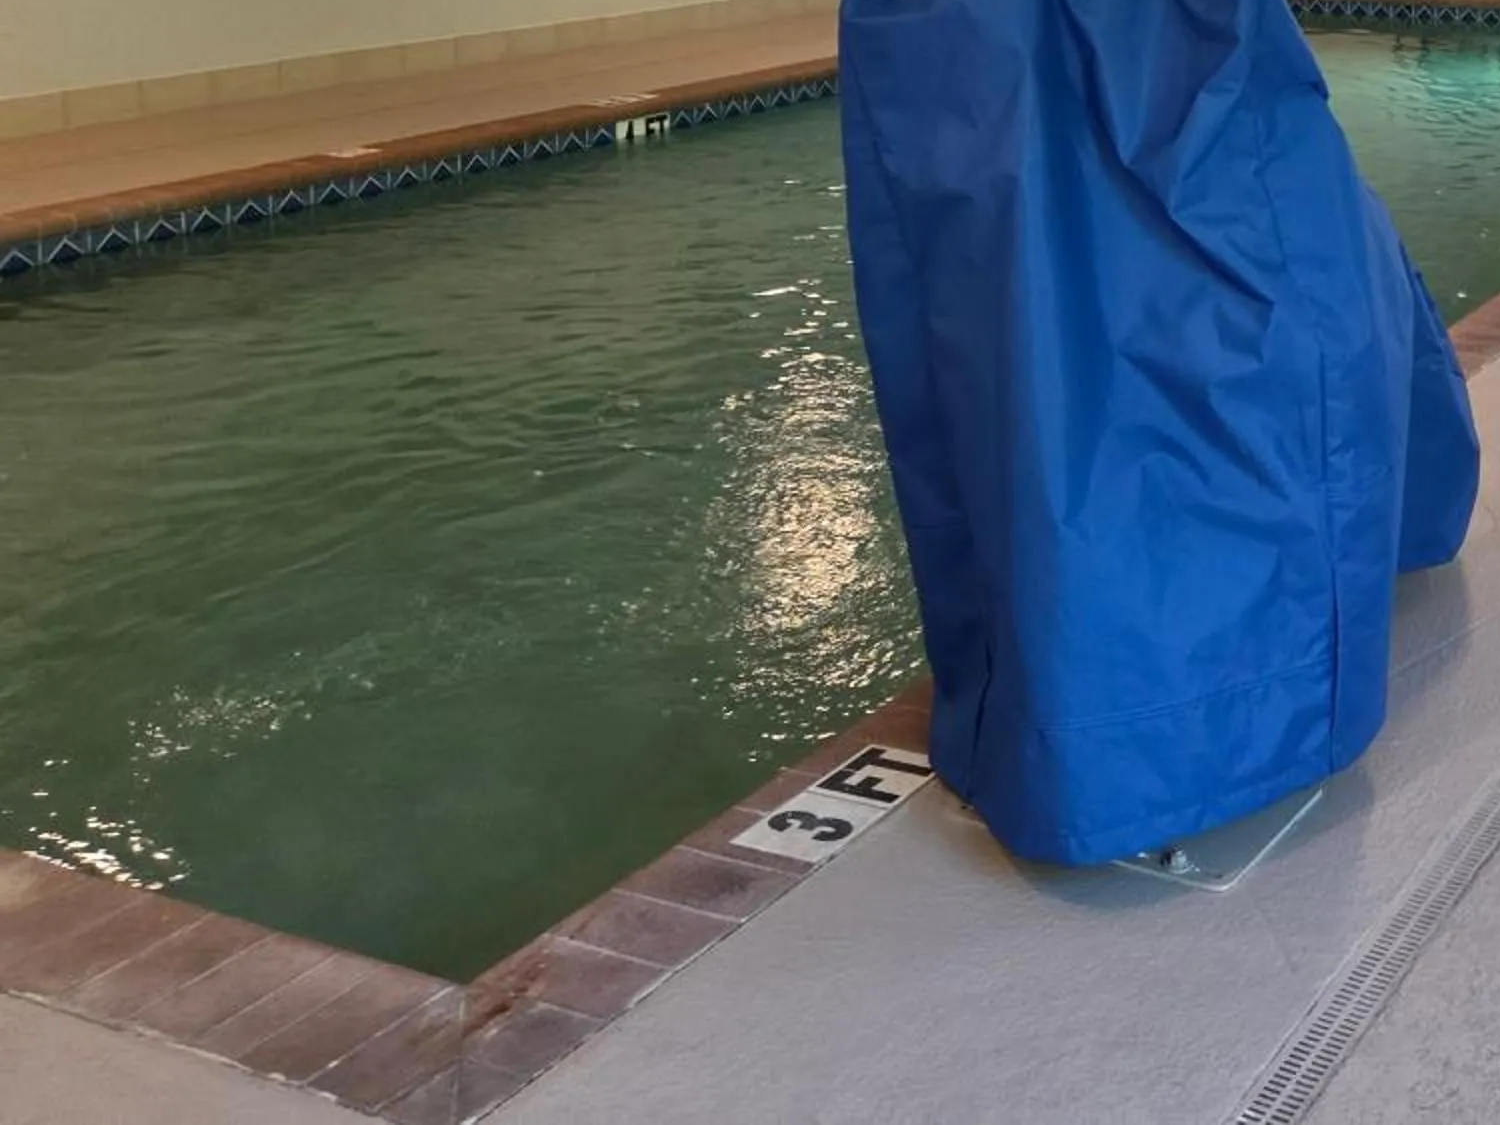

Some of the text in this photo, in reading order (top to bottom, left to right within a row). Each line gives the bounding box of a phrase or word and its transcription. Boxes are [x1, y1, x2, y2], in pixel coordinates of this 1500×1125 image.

[646, 115, 668, 136] FT
[768, 747, 934, 842] 3 FT
